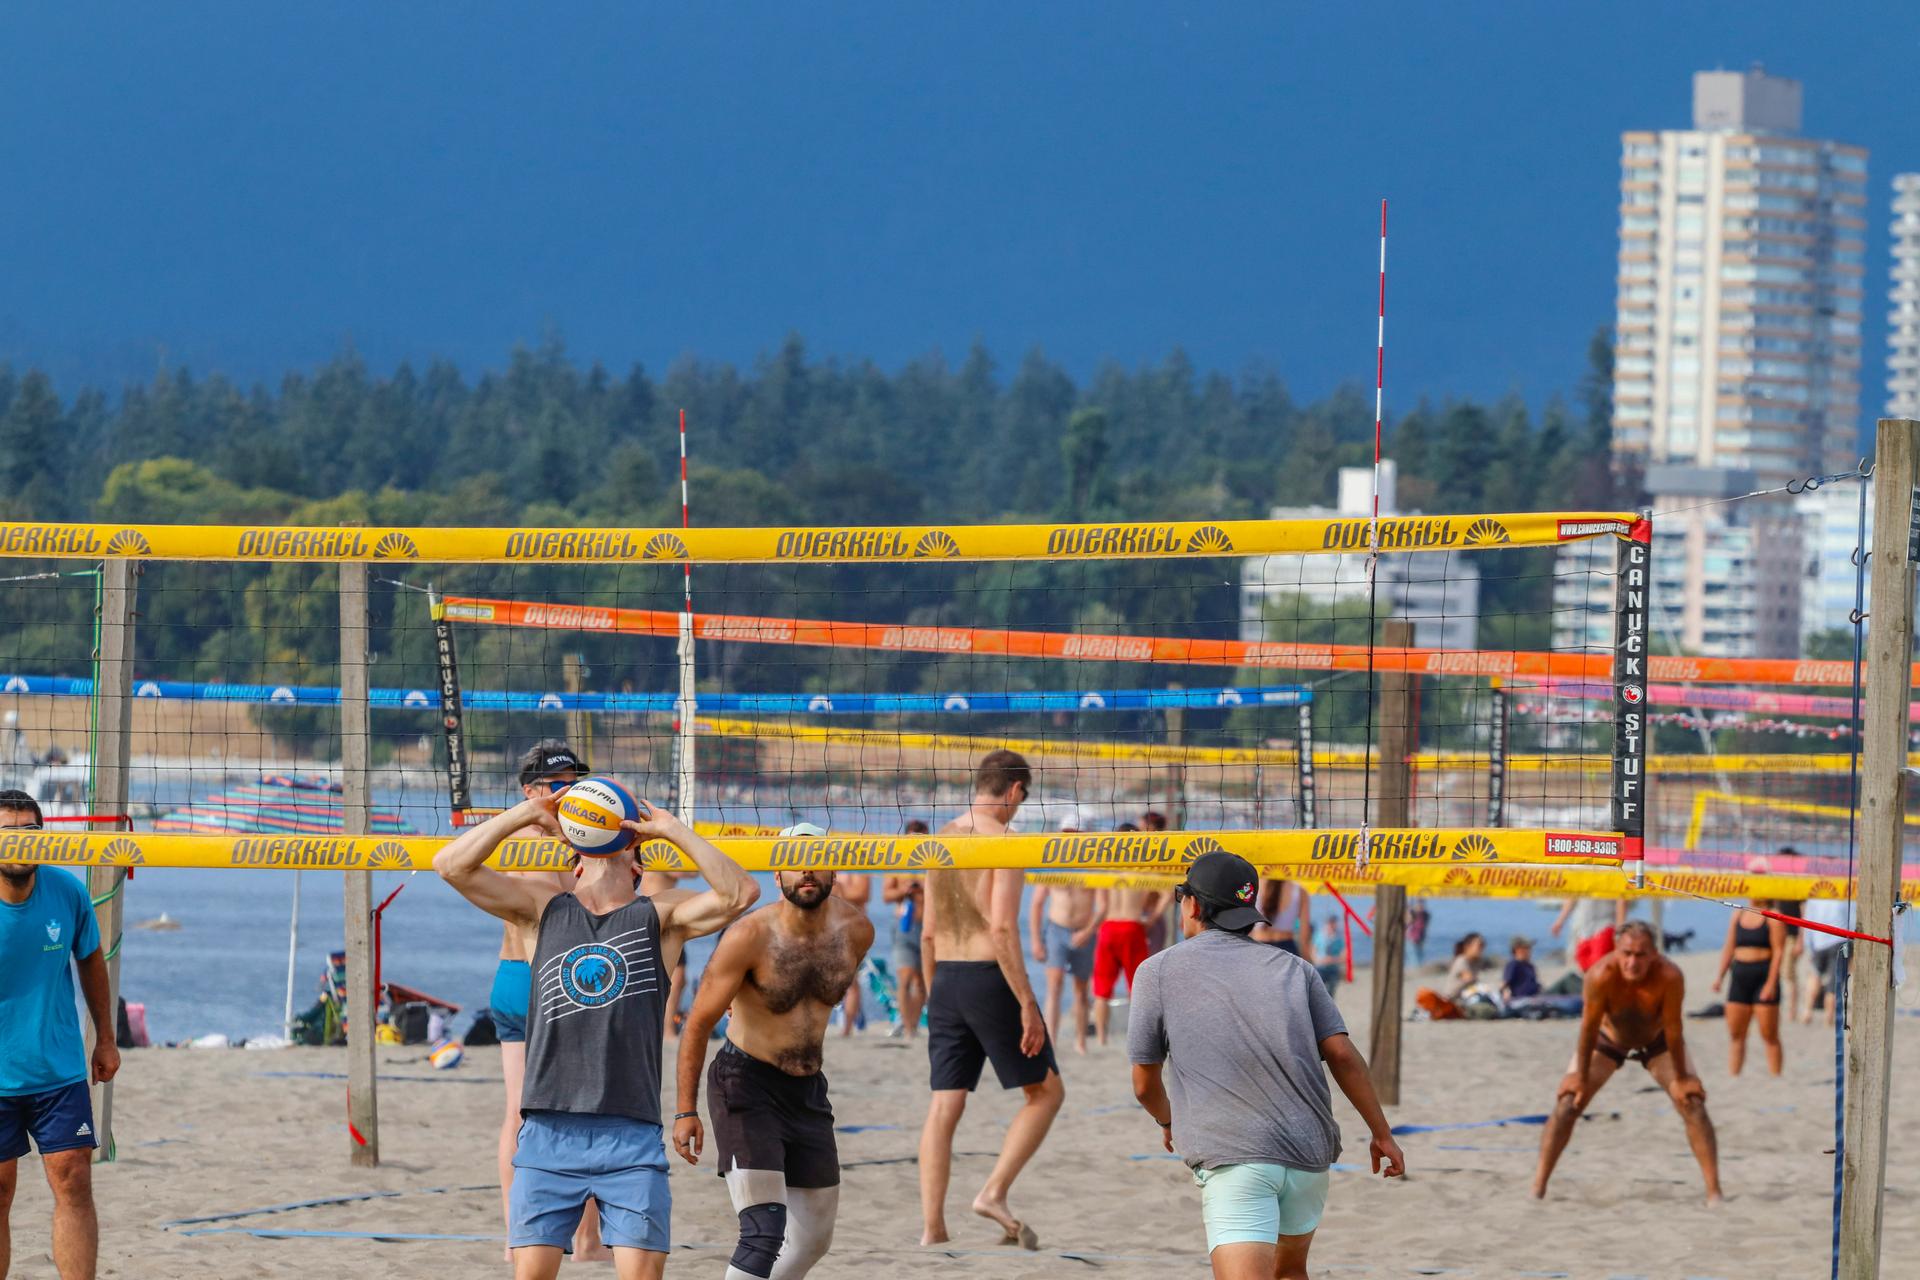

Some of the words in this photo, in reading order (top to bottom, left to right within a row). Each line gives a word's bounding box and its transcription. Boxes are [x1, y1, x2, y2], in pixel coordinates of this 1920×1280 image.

[1627, 546, 1645, 676] CANUCK
[1623, 713, 1641, 820] STUFF
[597, 792, 616, 805] PRO
[1547, 838, 1617, 855] 1-800-968-9306
